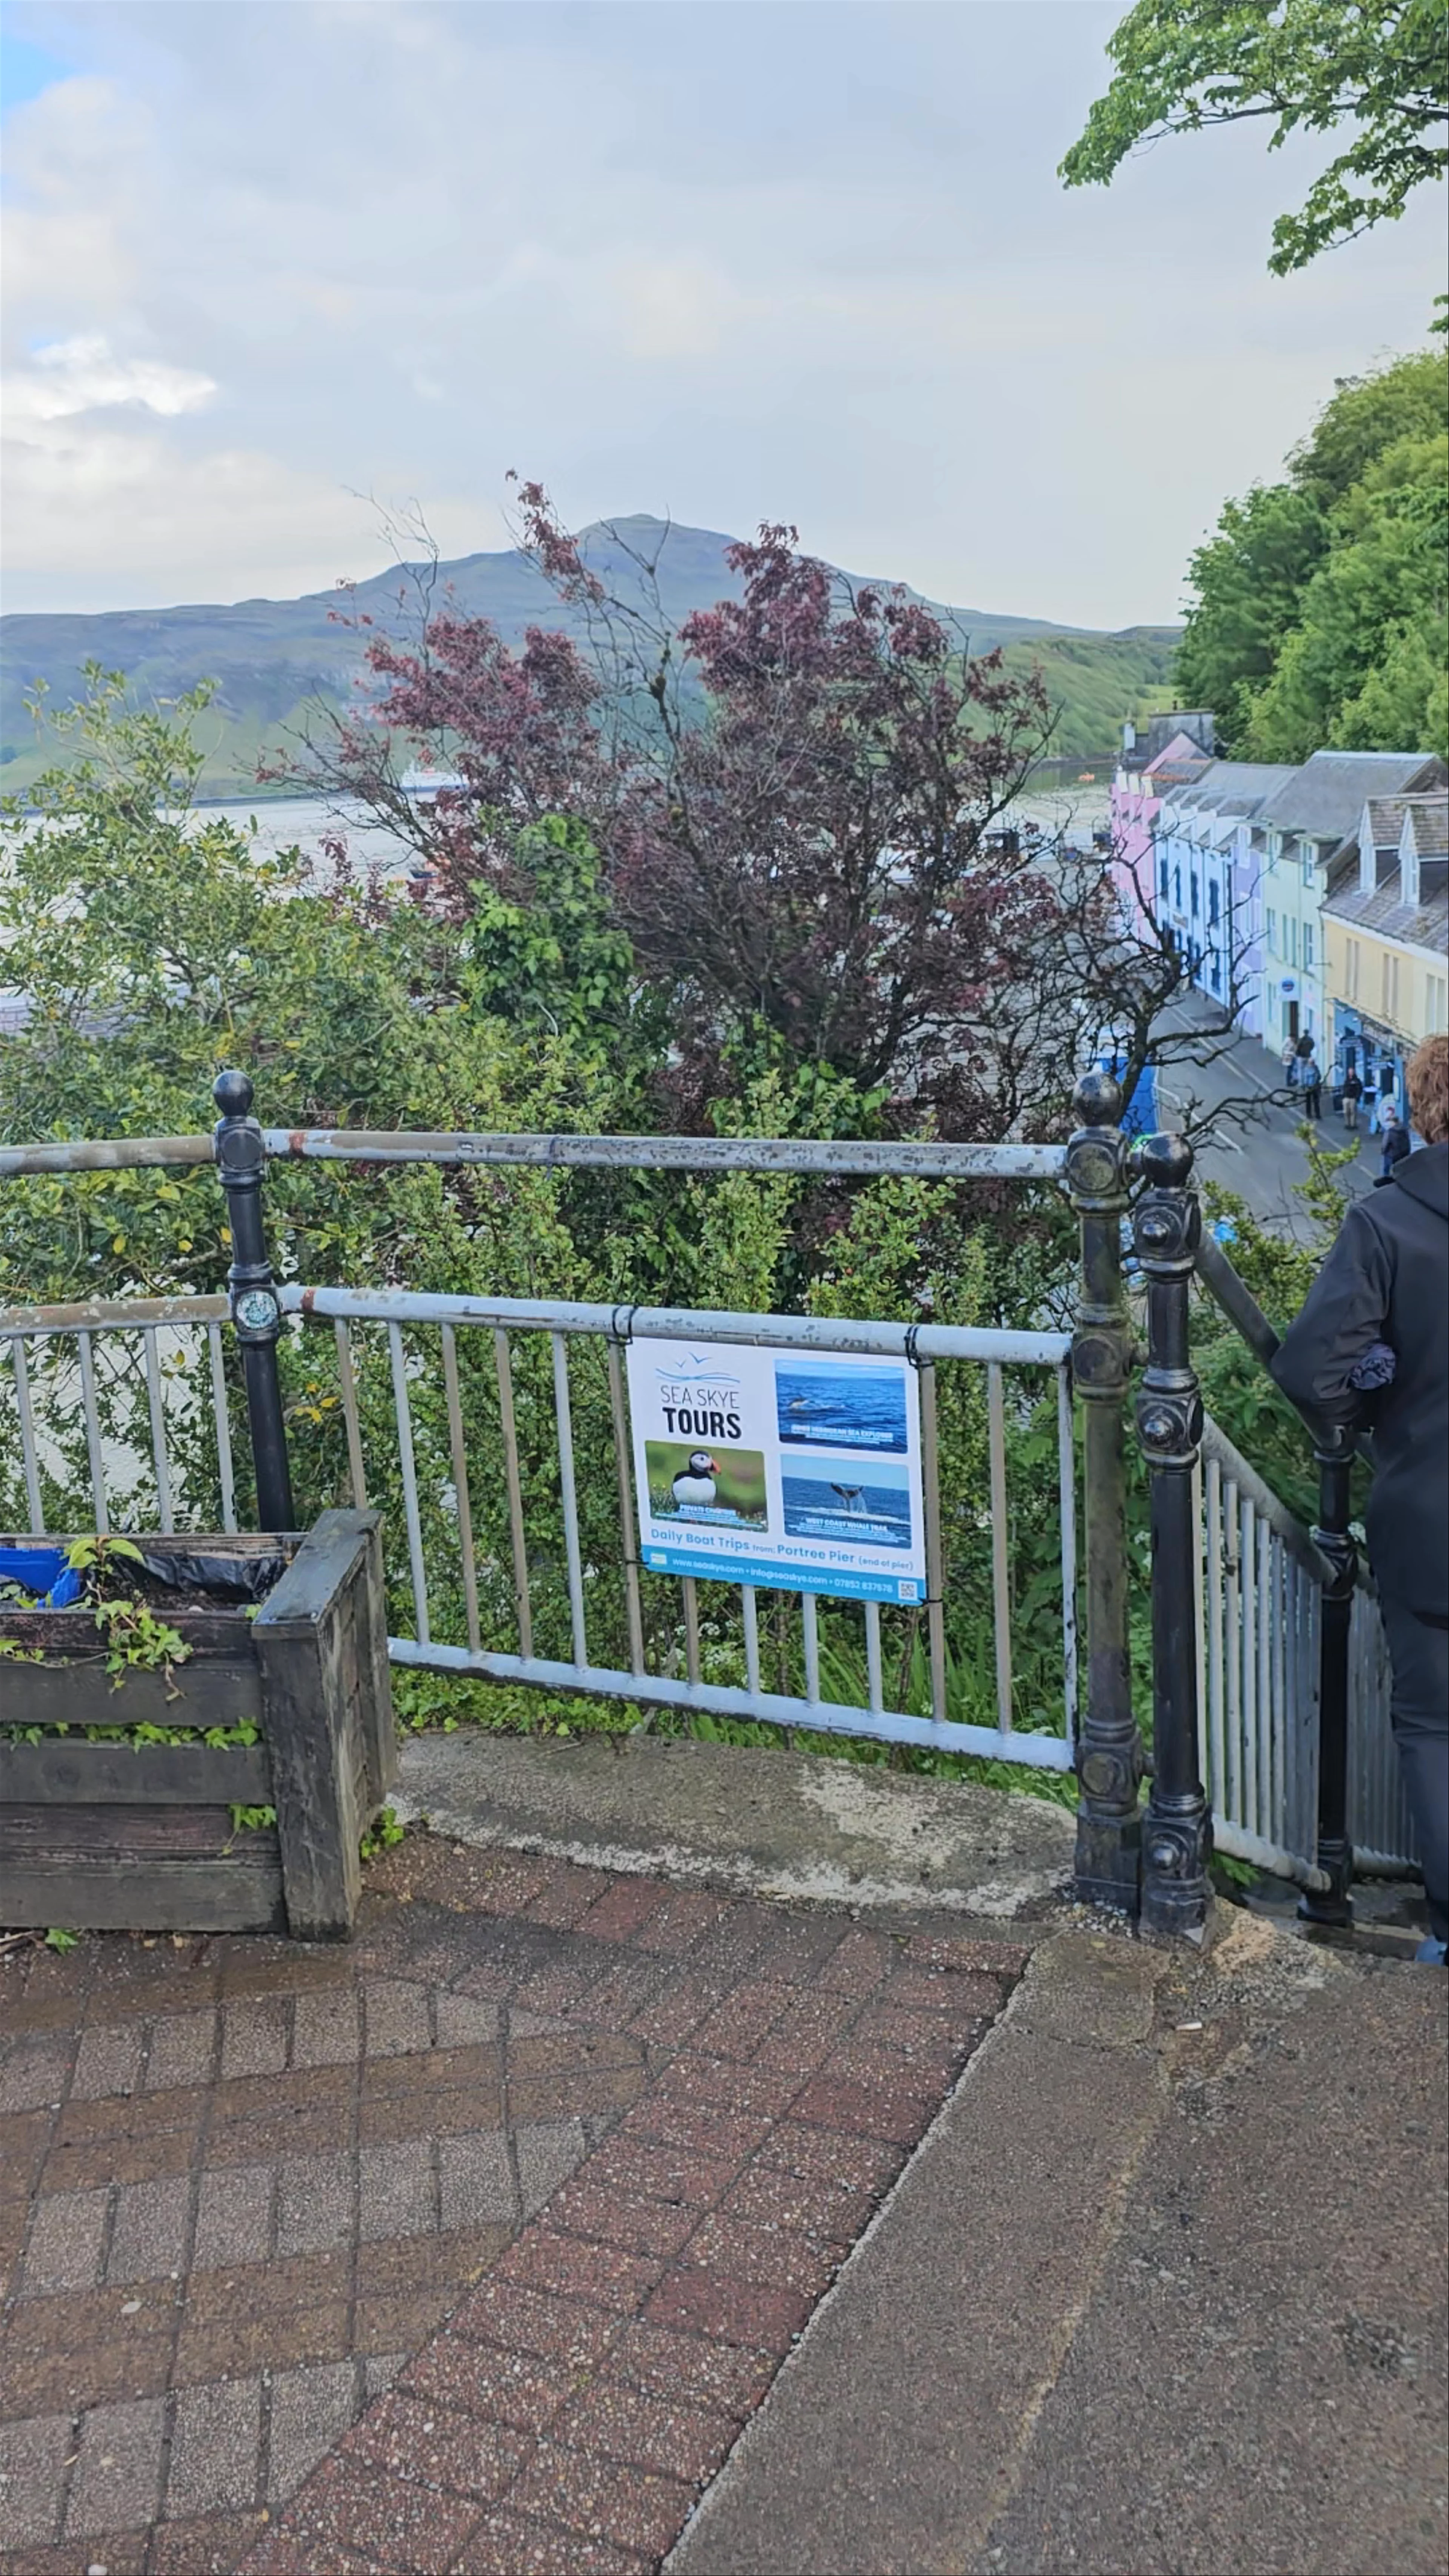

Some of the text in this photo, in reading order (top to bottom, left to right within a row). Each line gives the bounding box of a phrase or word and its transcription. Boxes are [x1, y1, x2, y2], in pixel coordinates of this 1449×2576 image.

[660, 1385, 740, 1409] SEA SKYE
[662, 1407, 741, 1439] TOURS
[824, 1519, 846, 1527] COAST
[651, 1529, 683, 1544] Daily
[686, 1533, 715, 1545] Boat
[718, 1537, 749, 1551] Trips
[777, 1545, 825, 1559] Portree
[830, 1551, 855, 1563] Pier
[858, 1556, 879, 1567] (end
[892, 1561, 914, 1571] pier)
[672, 1558, 744, 1575] www.seaskye.com
[751, 1567, 828, 1585] info@seaskye.com
